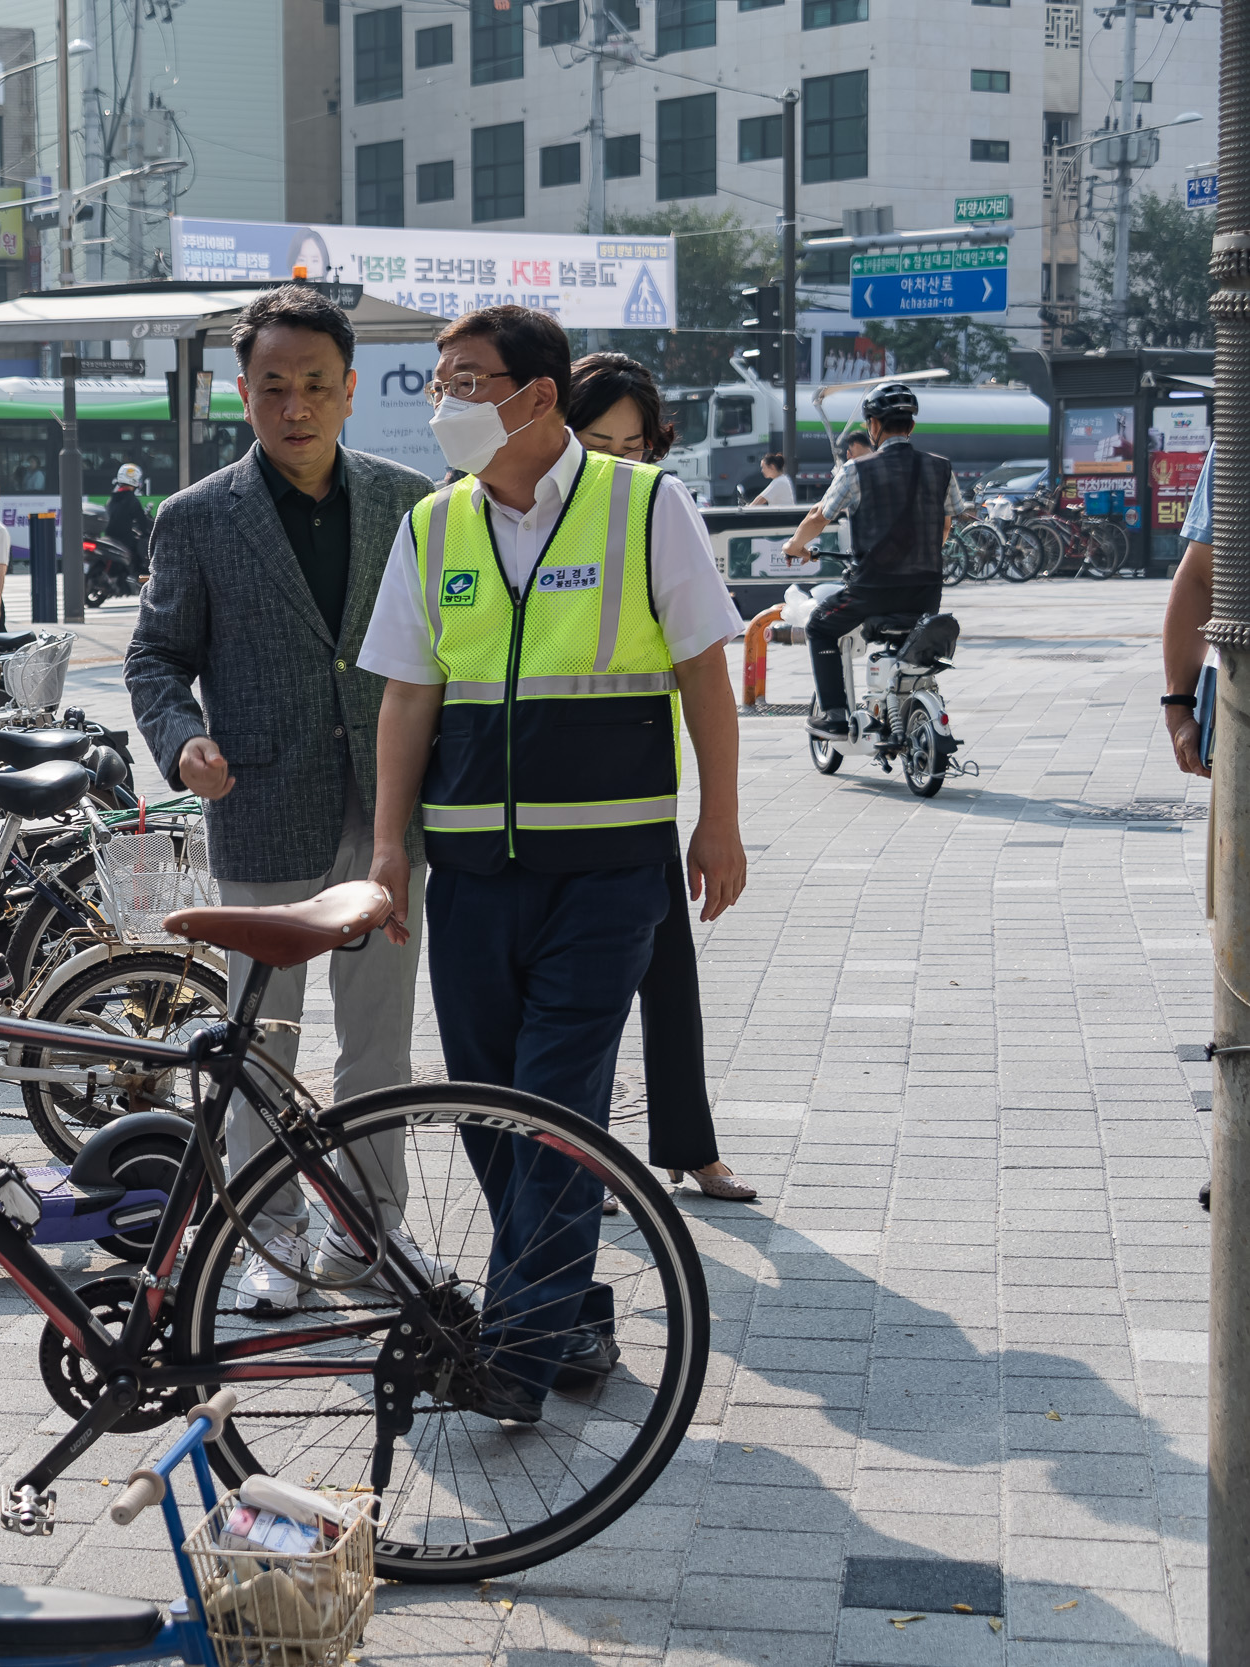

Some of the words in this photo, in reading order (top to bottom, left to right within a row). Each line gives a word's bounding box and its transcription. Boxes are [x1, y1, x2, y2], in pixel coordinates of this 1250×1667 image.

[957, 199, 1006, 217] 자양사거리
[913, 253, 950, 269] 잠실대교
[955, 251, 994, 266] 건대입구역
[901, 275, 954, 295] 아차산로
[900, 297, 954, 309] Achasan-ro
[152, 323, 180, 334] 광진구
[555, 577, 596, 588] 광진구청장
[259, 1107, 282, 1135] alton
[405, 1110, 540, 1138] VELOX
[69, 1427, 94, 1453] alton
[374, 1540, 478, 1559] VELO
